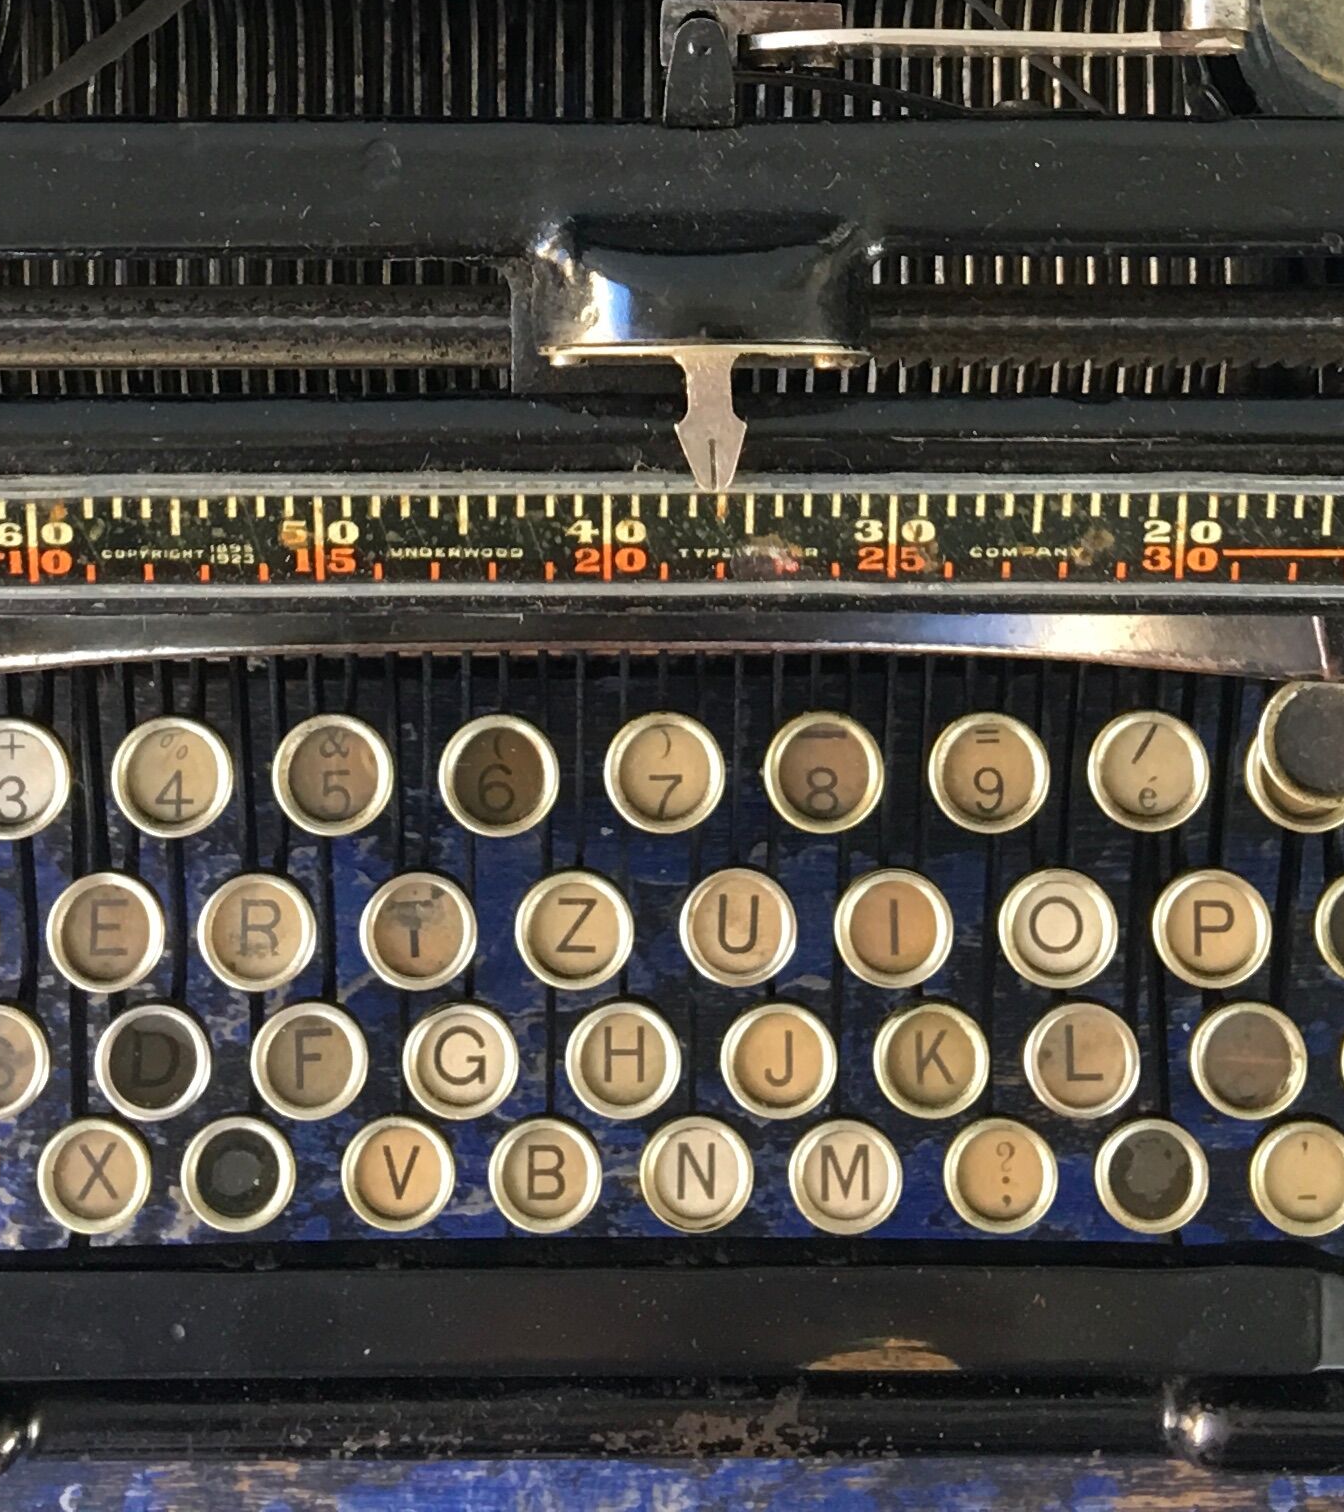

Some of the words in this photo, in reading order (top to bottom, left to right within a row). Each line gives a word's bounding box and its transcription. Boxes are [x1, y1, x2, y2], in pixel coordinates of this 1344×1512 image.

[101, 548, 205, 561] COPYRIGHT
[390, 548, 524, 559] UNDERWOOD
[970, 546, 1083, 559] COMPANY
[567, 519, 646, 544] 40
[855, 518, 935, 544] 30
[1143, 518, 1221, 544] 20
[7, 549, 72, 575] 10
[293, 548, 355, 574] 15
[574, 546, 646, 573] 20
[858, 546, 924, 572] 25
[1141, 546, 1216, 571] 30
[154, 770, 194, 818] 4
[322, 769, 351, 815] 5
[477, 763, 515, 812] 6
[647, 773, 683, 820] 7
[804, 766, 839, 816] 8
[974, 767, 1003, 813] 9
[88, 898, 129, 956] E
[237, 897, 281, 956] R
[387, 899, 432, 958] T
[556, 897, 597, 954] Z
[717, 893, 760, 954] U
[1029, 896, 1083, 954] O
[1194, 899, 1234, 956] P
[130, 1030, 179, 1088] D
[293, 1028, 332, 1090] F
[433, 1026, 486, 1085] G
[603, 1026, 646, 1083] H
[764, 1030, 793, 1087] J
[913, 1029, 956, 1085] K
[1065, 1024, 1104, 1082] L
[78, 1142, 117, 1200] X
[383, 1144, 420, 1200] V
[526, 1144, 566, 1201] B
[677, 1143, 715, 1200] N
[819, 1144, 870, 1200] M
